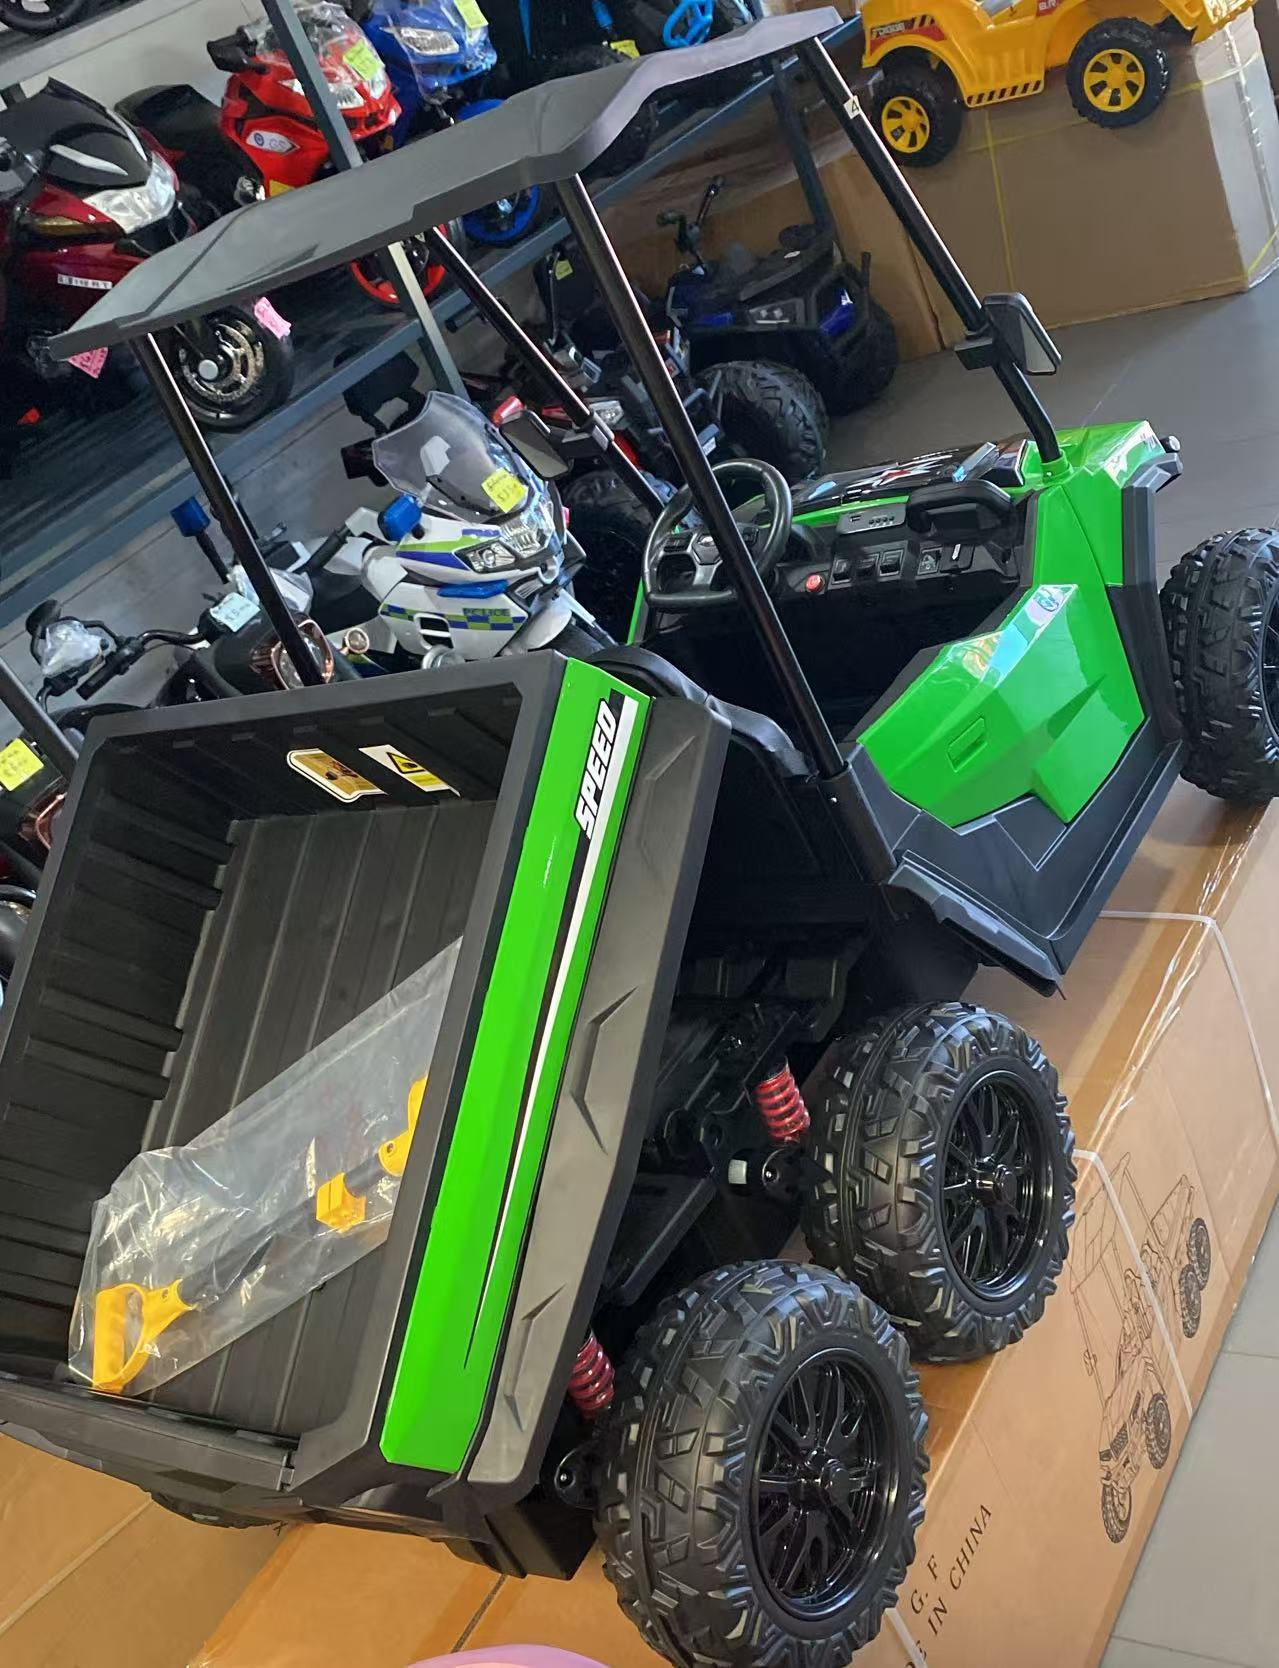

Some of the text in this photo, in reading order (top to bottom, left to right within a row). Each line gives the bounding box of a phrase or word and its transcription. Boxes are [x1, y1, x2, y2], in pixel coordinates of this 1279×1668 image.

[462, 607, 511, 617] POLICE
[574, 698, 618, 840] SPEED
[926, 1554, 938, 1581] F
[928, 1504, 992, 1636] IN CHINA
